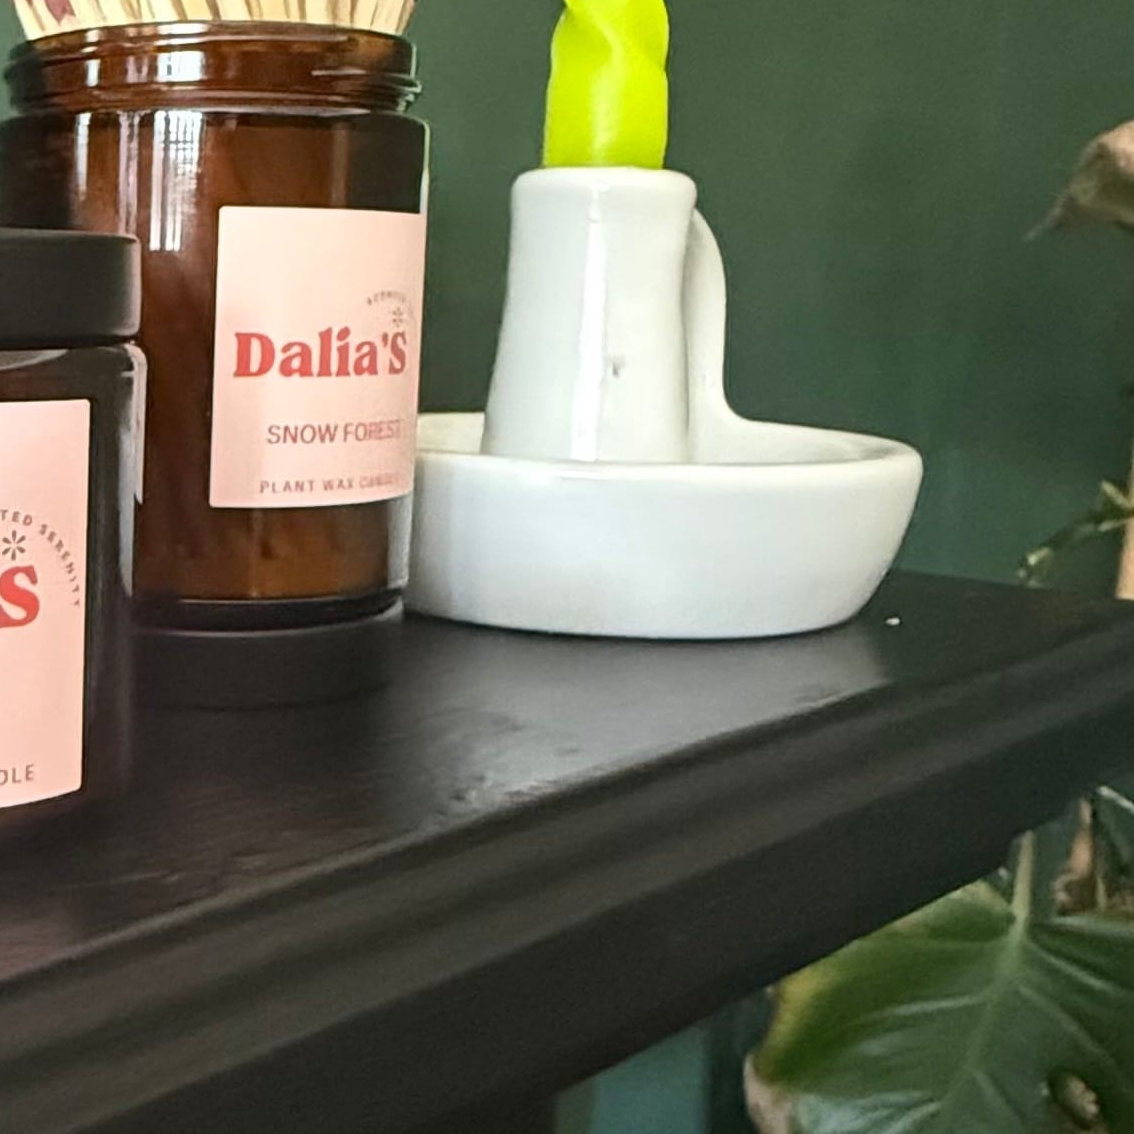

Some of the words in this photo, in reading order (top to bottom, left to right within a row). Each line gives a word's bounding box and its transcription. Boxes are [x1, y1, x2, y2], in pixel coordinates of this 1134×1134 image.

[233, 326, 408, 378] Dalia'S
[266, 422, 339, 444] SNOW
[343, 419, 401, 443] FOREST
[259, 478, 315, 494] PLANT
[322, 478, 354, 492] WAX
